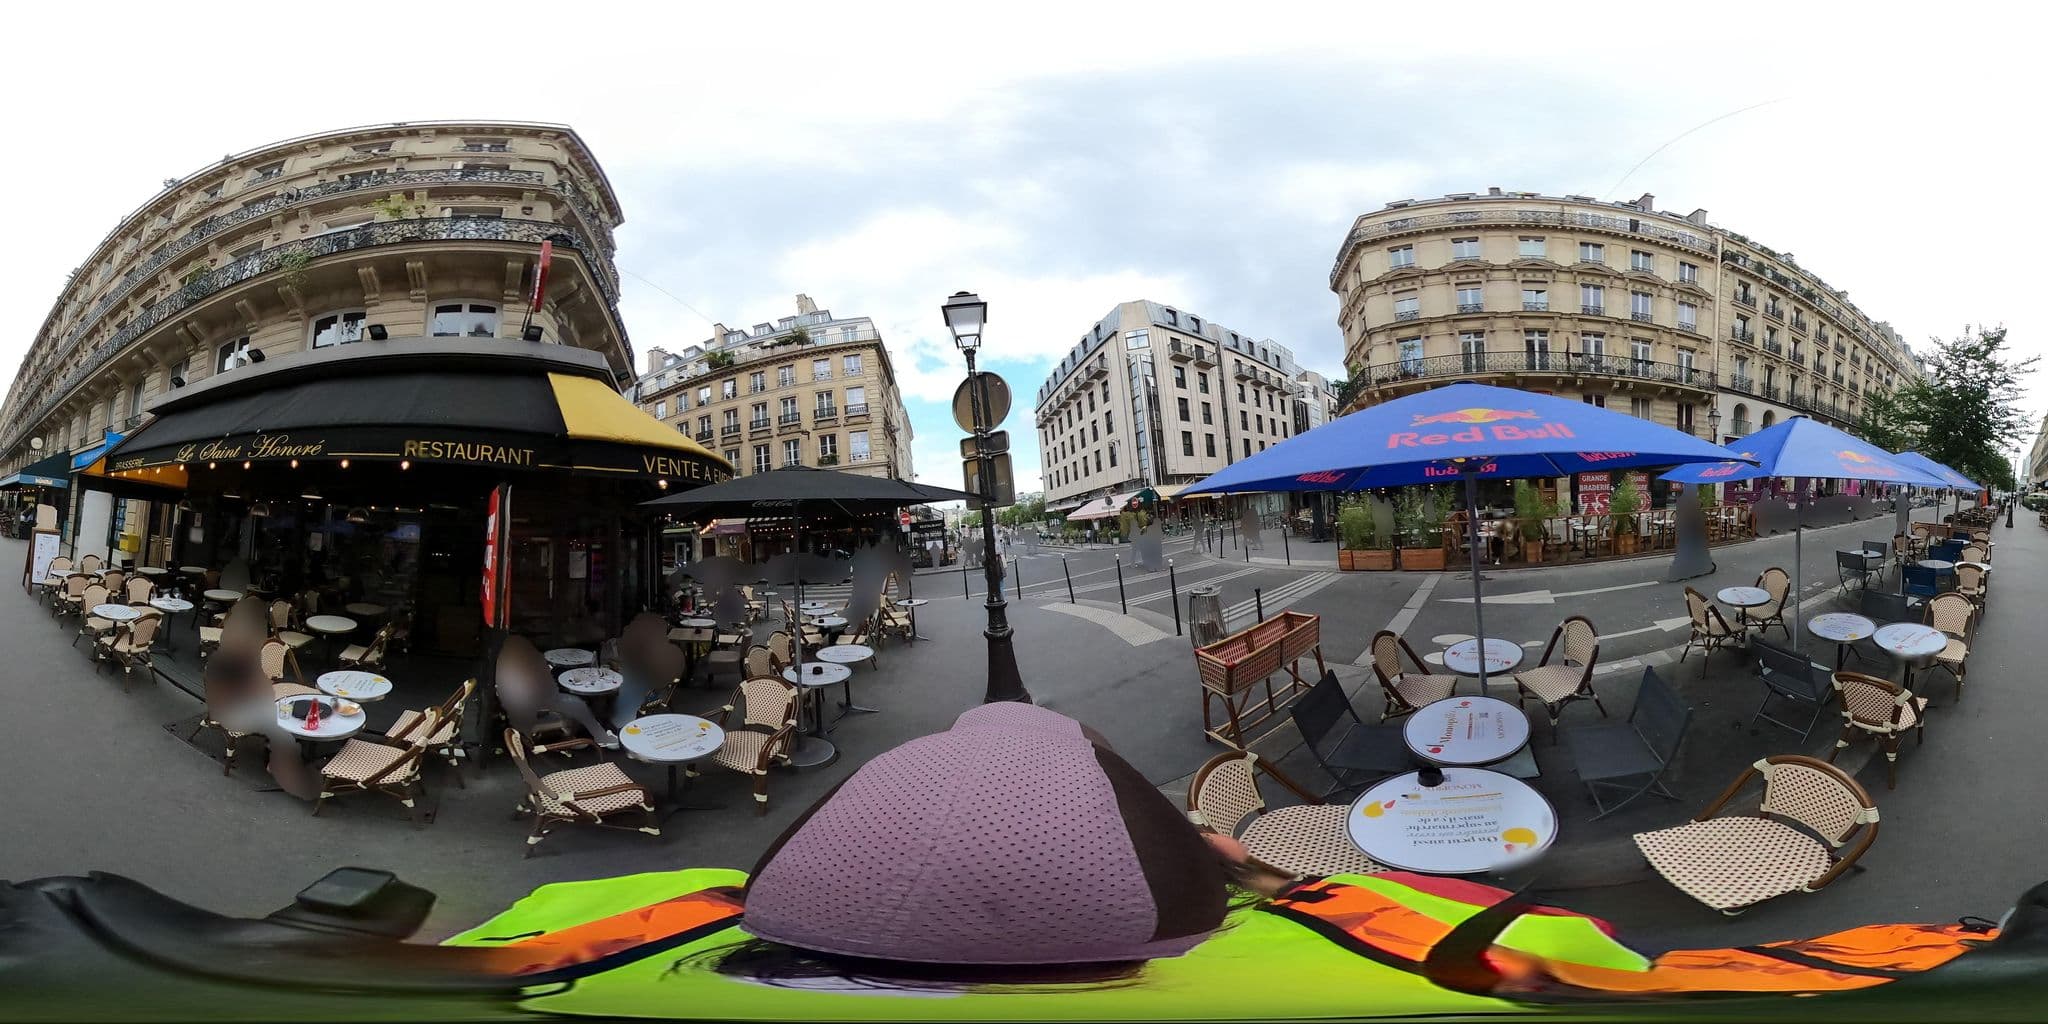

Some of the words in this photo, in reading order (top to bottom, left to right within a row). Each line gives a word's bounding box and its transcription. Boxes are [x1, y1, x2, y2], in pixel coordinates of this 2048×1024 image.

[1387, 426, 1485, 449] Red
[1491, 422, 1576, 441] Bull
[174, 443, 195, 462] Le
[200, 440, 242, 460] Saint
[248, 434, 326, 457] Honoré
[404, 440, 535, 466] RESTAURANT
[115, 457, 145, 469] BRASSERIE
[643, 455, 700, 479] VENTE
[1579, 483, 1611, 491] BRADERIE
[1581, 474, 1608, 482] GRANDE
